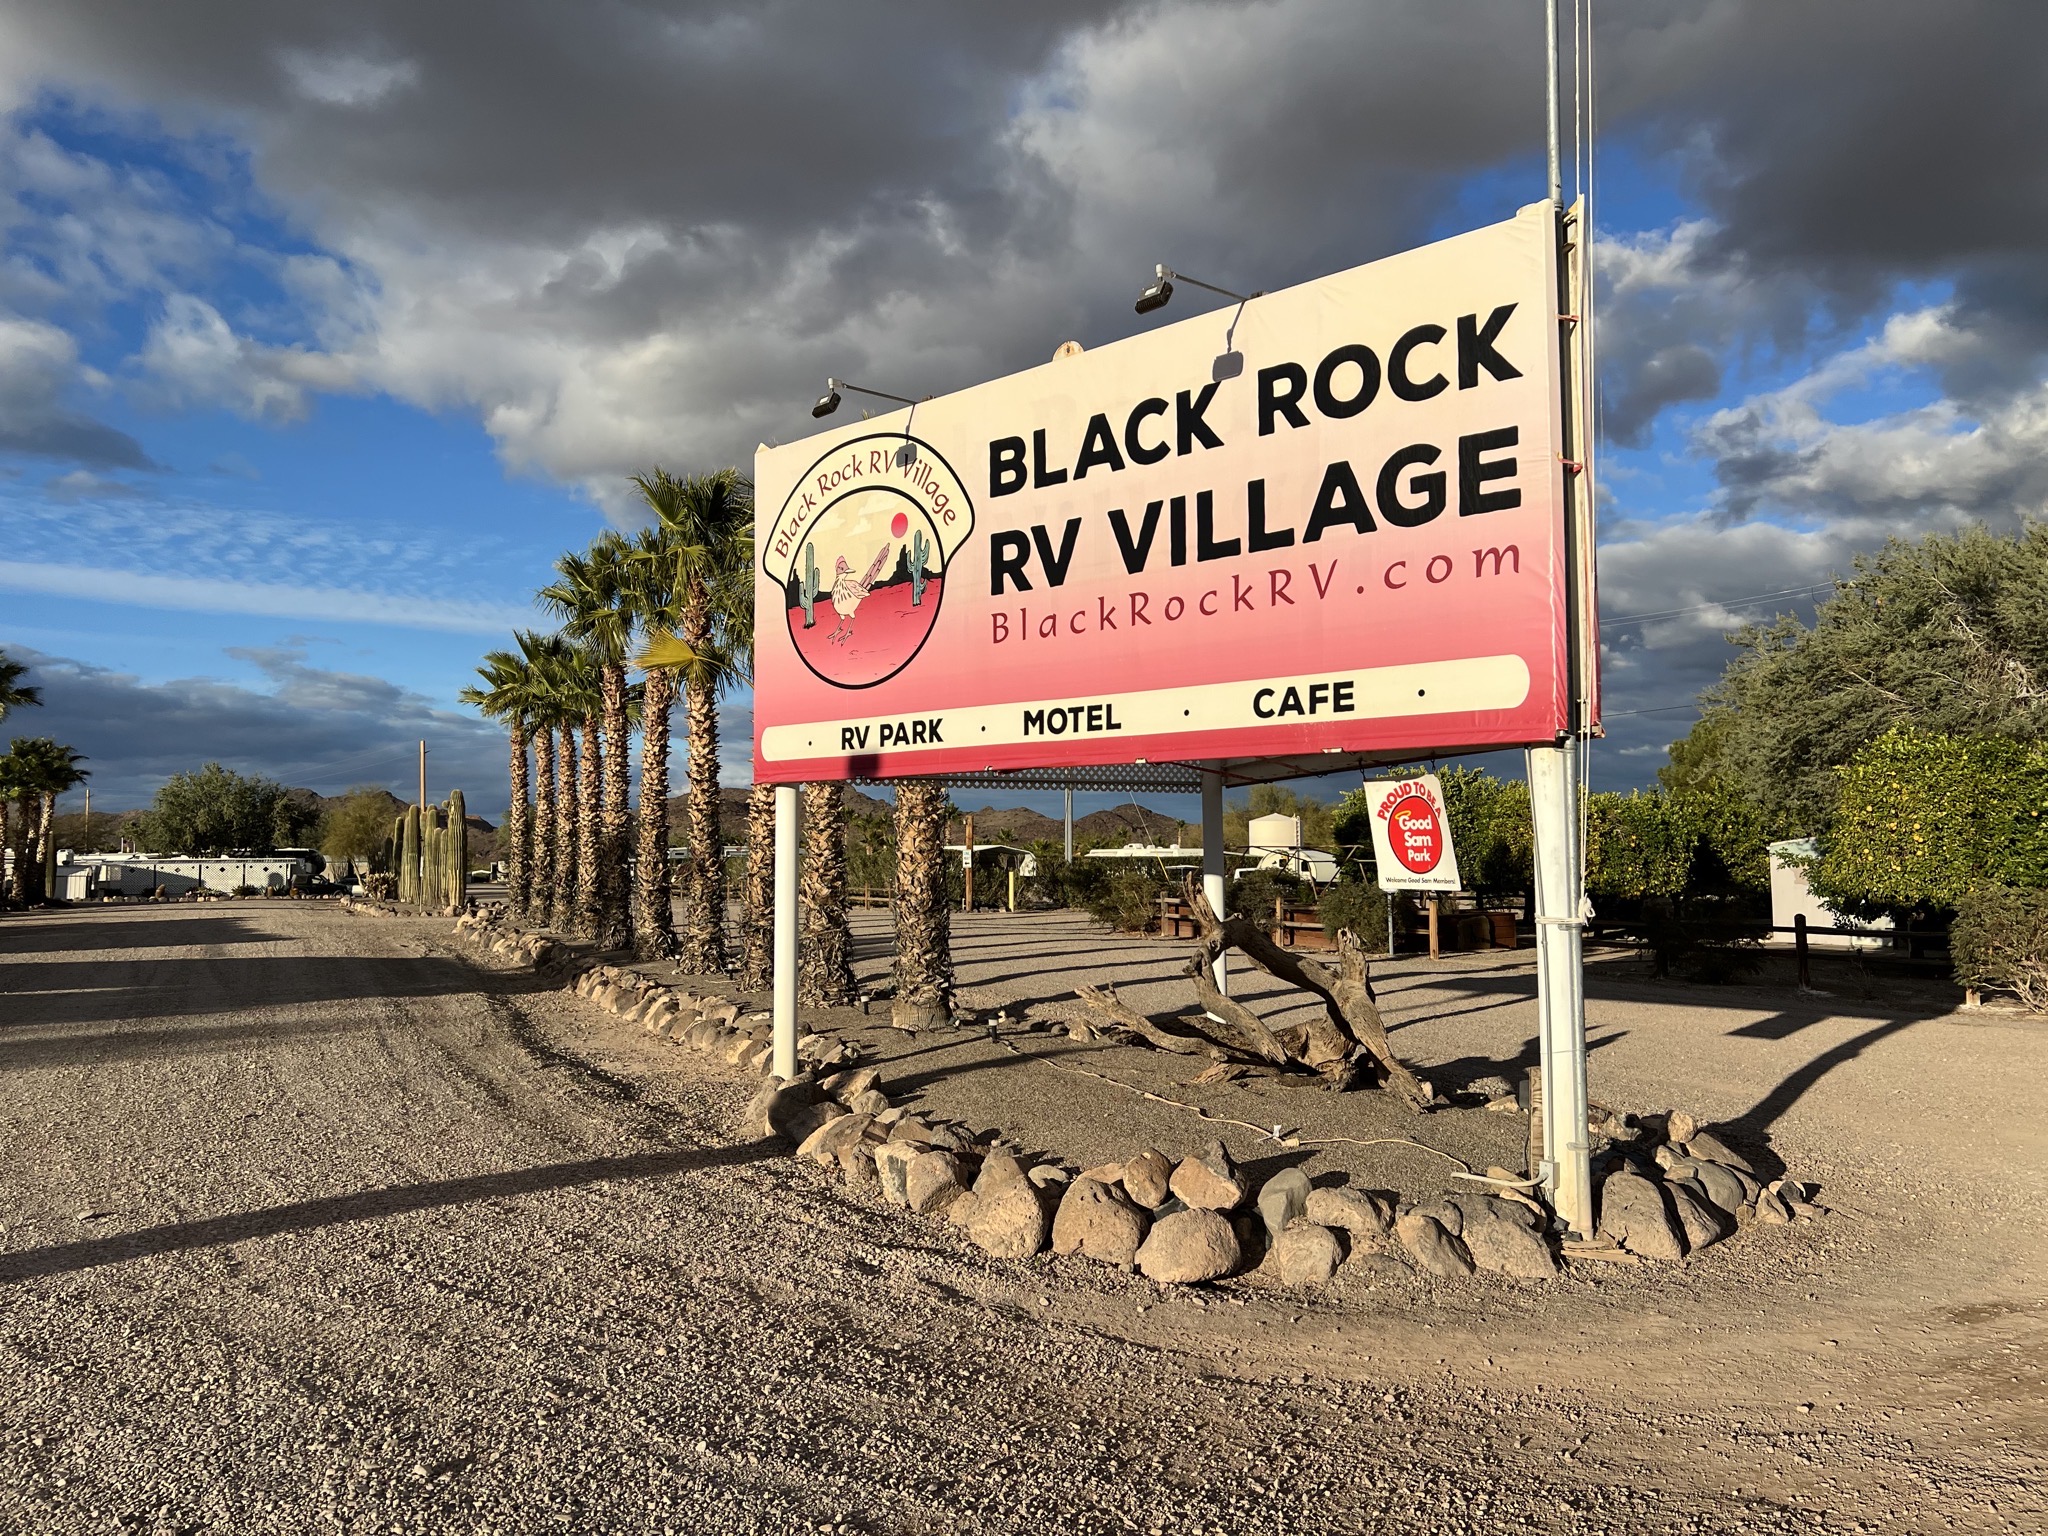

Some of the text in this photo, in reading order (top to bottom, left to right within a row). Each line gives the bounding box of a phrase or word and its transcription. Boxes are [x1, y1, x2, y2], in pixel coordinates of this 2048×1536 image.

[989, 302, 1523, 498] BLACK ROCK
[774, 450, 956, 558] Black Rock RV Village
[990, 426, 1522, 596] RV VILLAGE
[991, 544, 1520, 643] BlackRockRV.com
[841, 681, 1355, 750] RV PARK MOTEL CAFE
[1377, 781, 1441, 821] PROUD TO BE A
[1399, 815, 1432, 830] Good
[1404, 832, 1432, 847] Sam
[1407, 848, 1431, 861] Park
